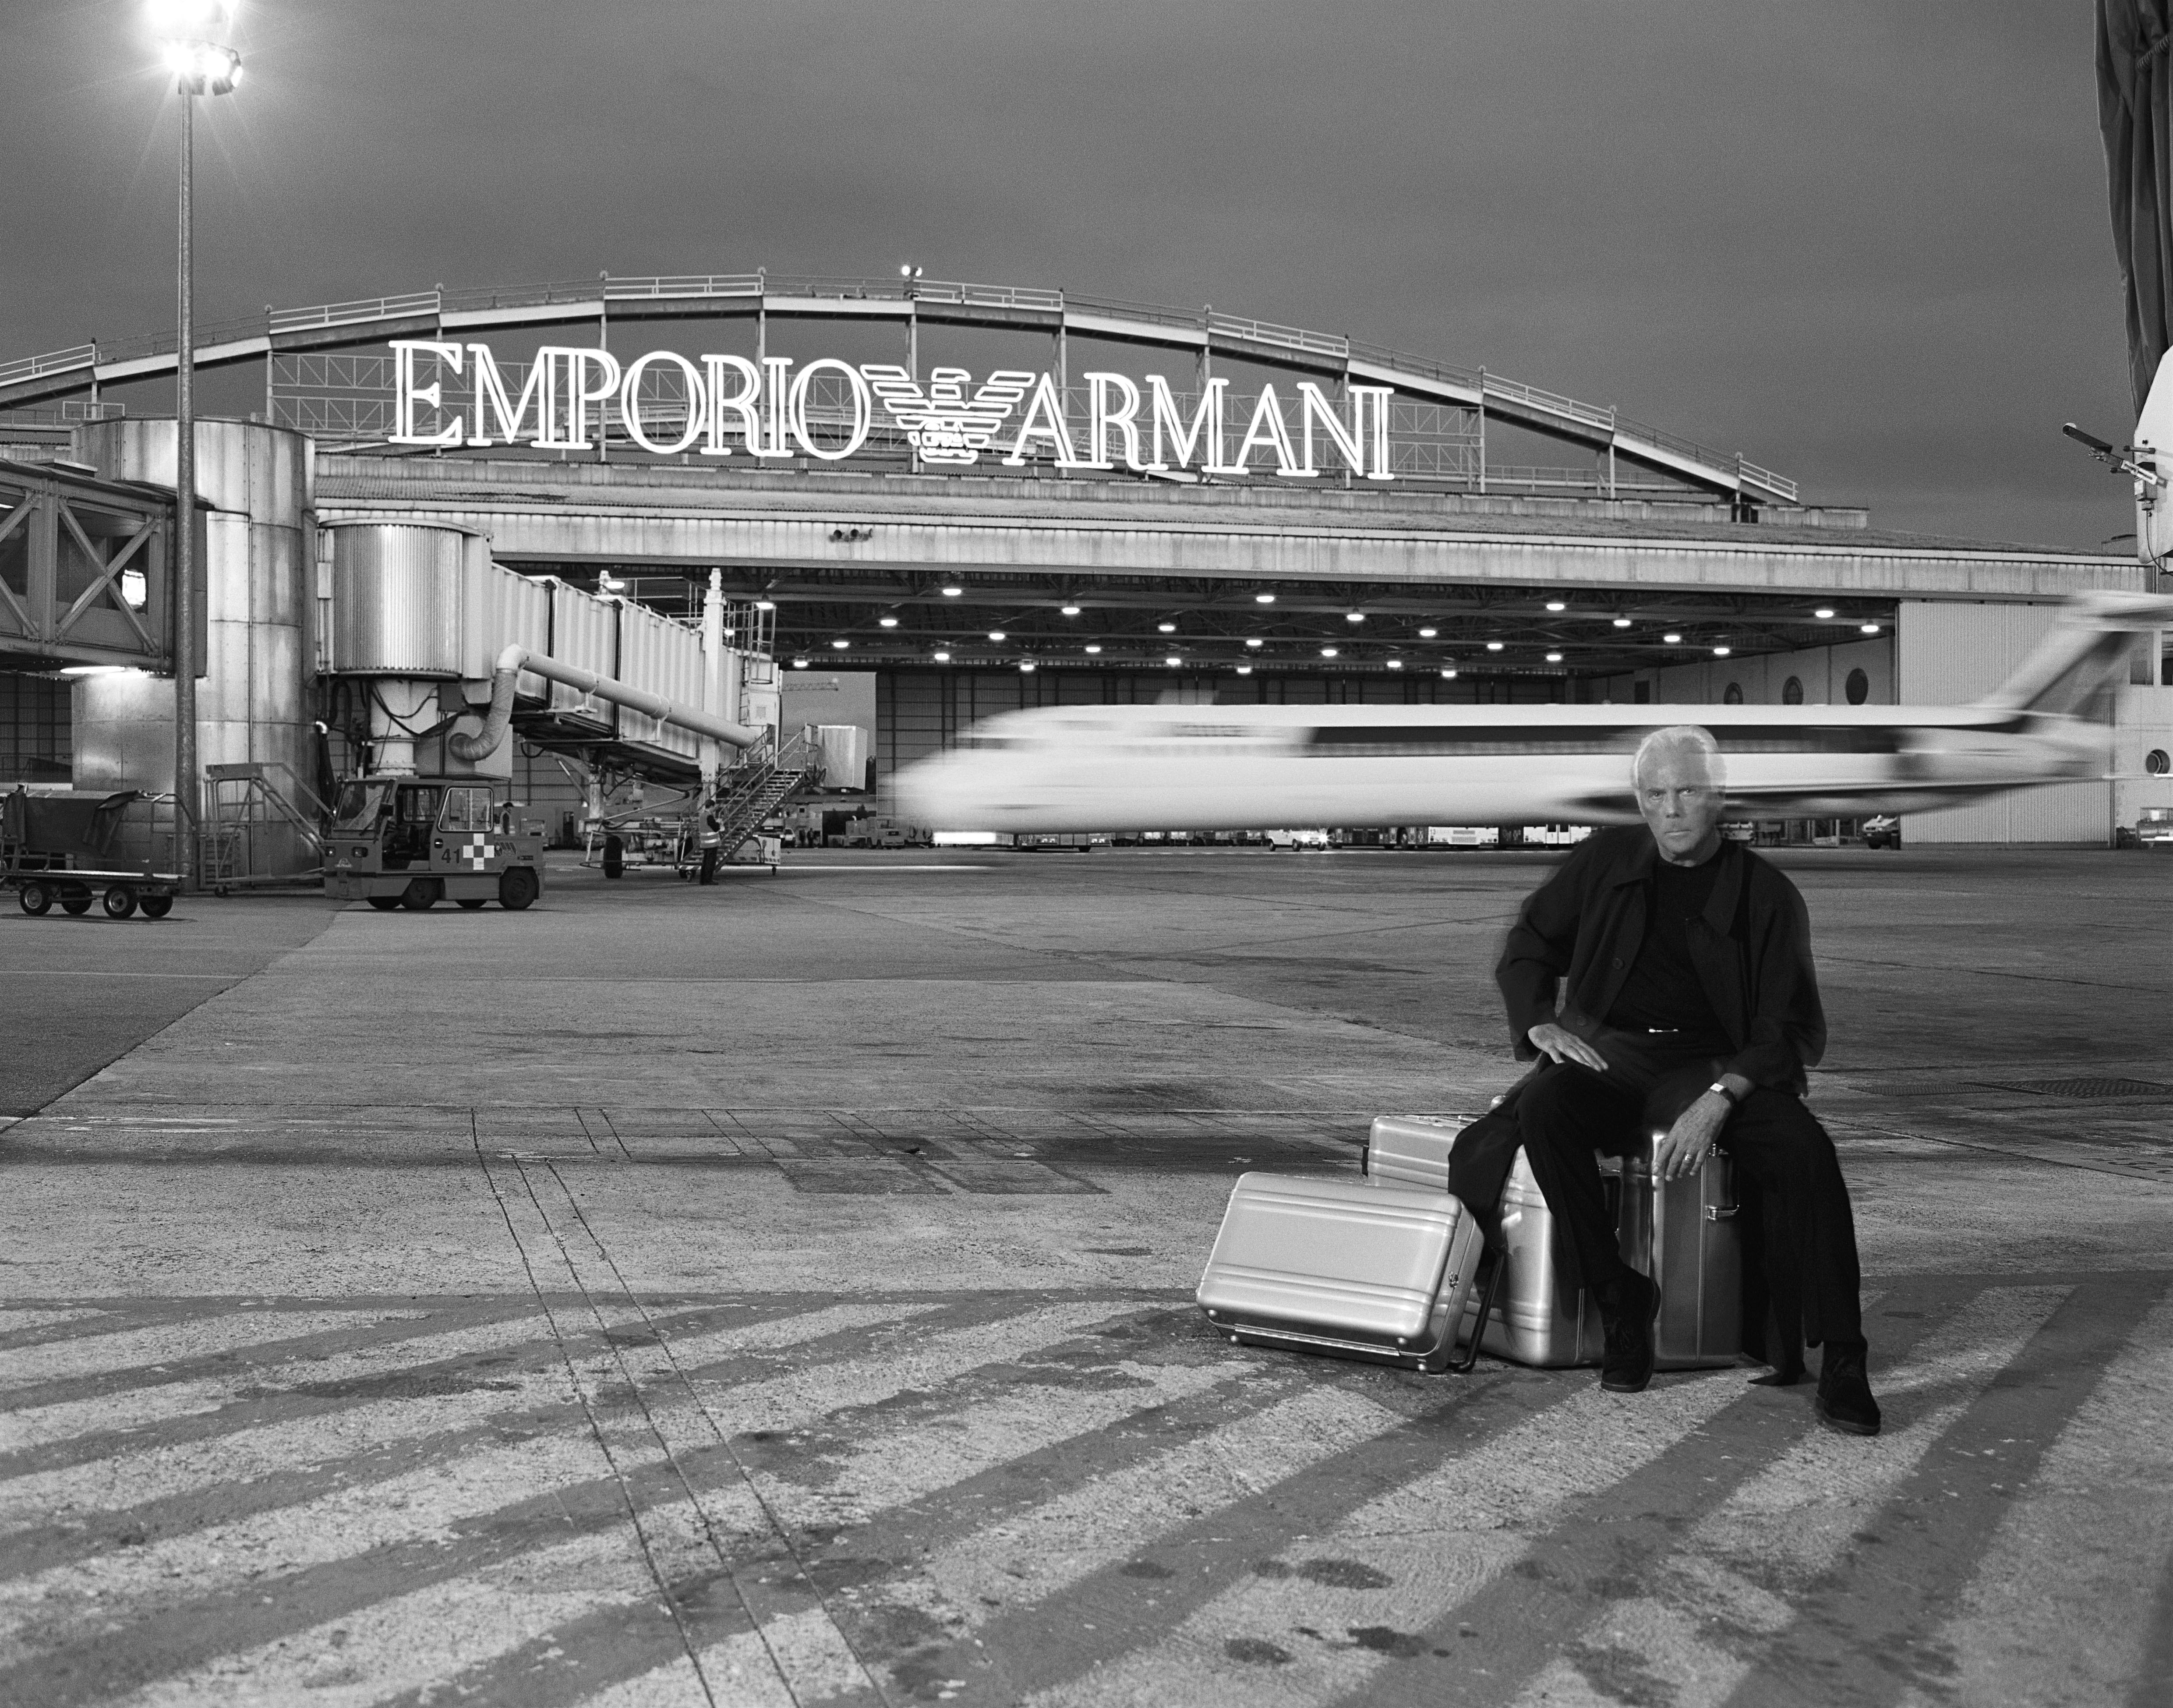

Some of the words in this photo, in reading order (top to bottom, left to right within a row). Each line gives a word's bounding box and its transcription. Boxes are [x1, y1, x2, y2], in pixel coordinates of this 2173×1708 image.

[388, 340, 872, 460] EMPORIO
[1002, 372, 1395, 480] ARMANI
[441, 849, 459, 863] 41
